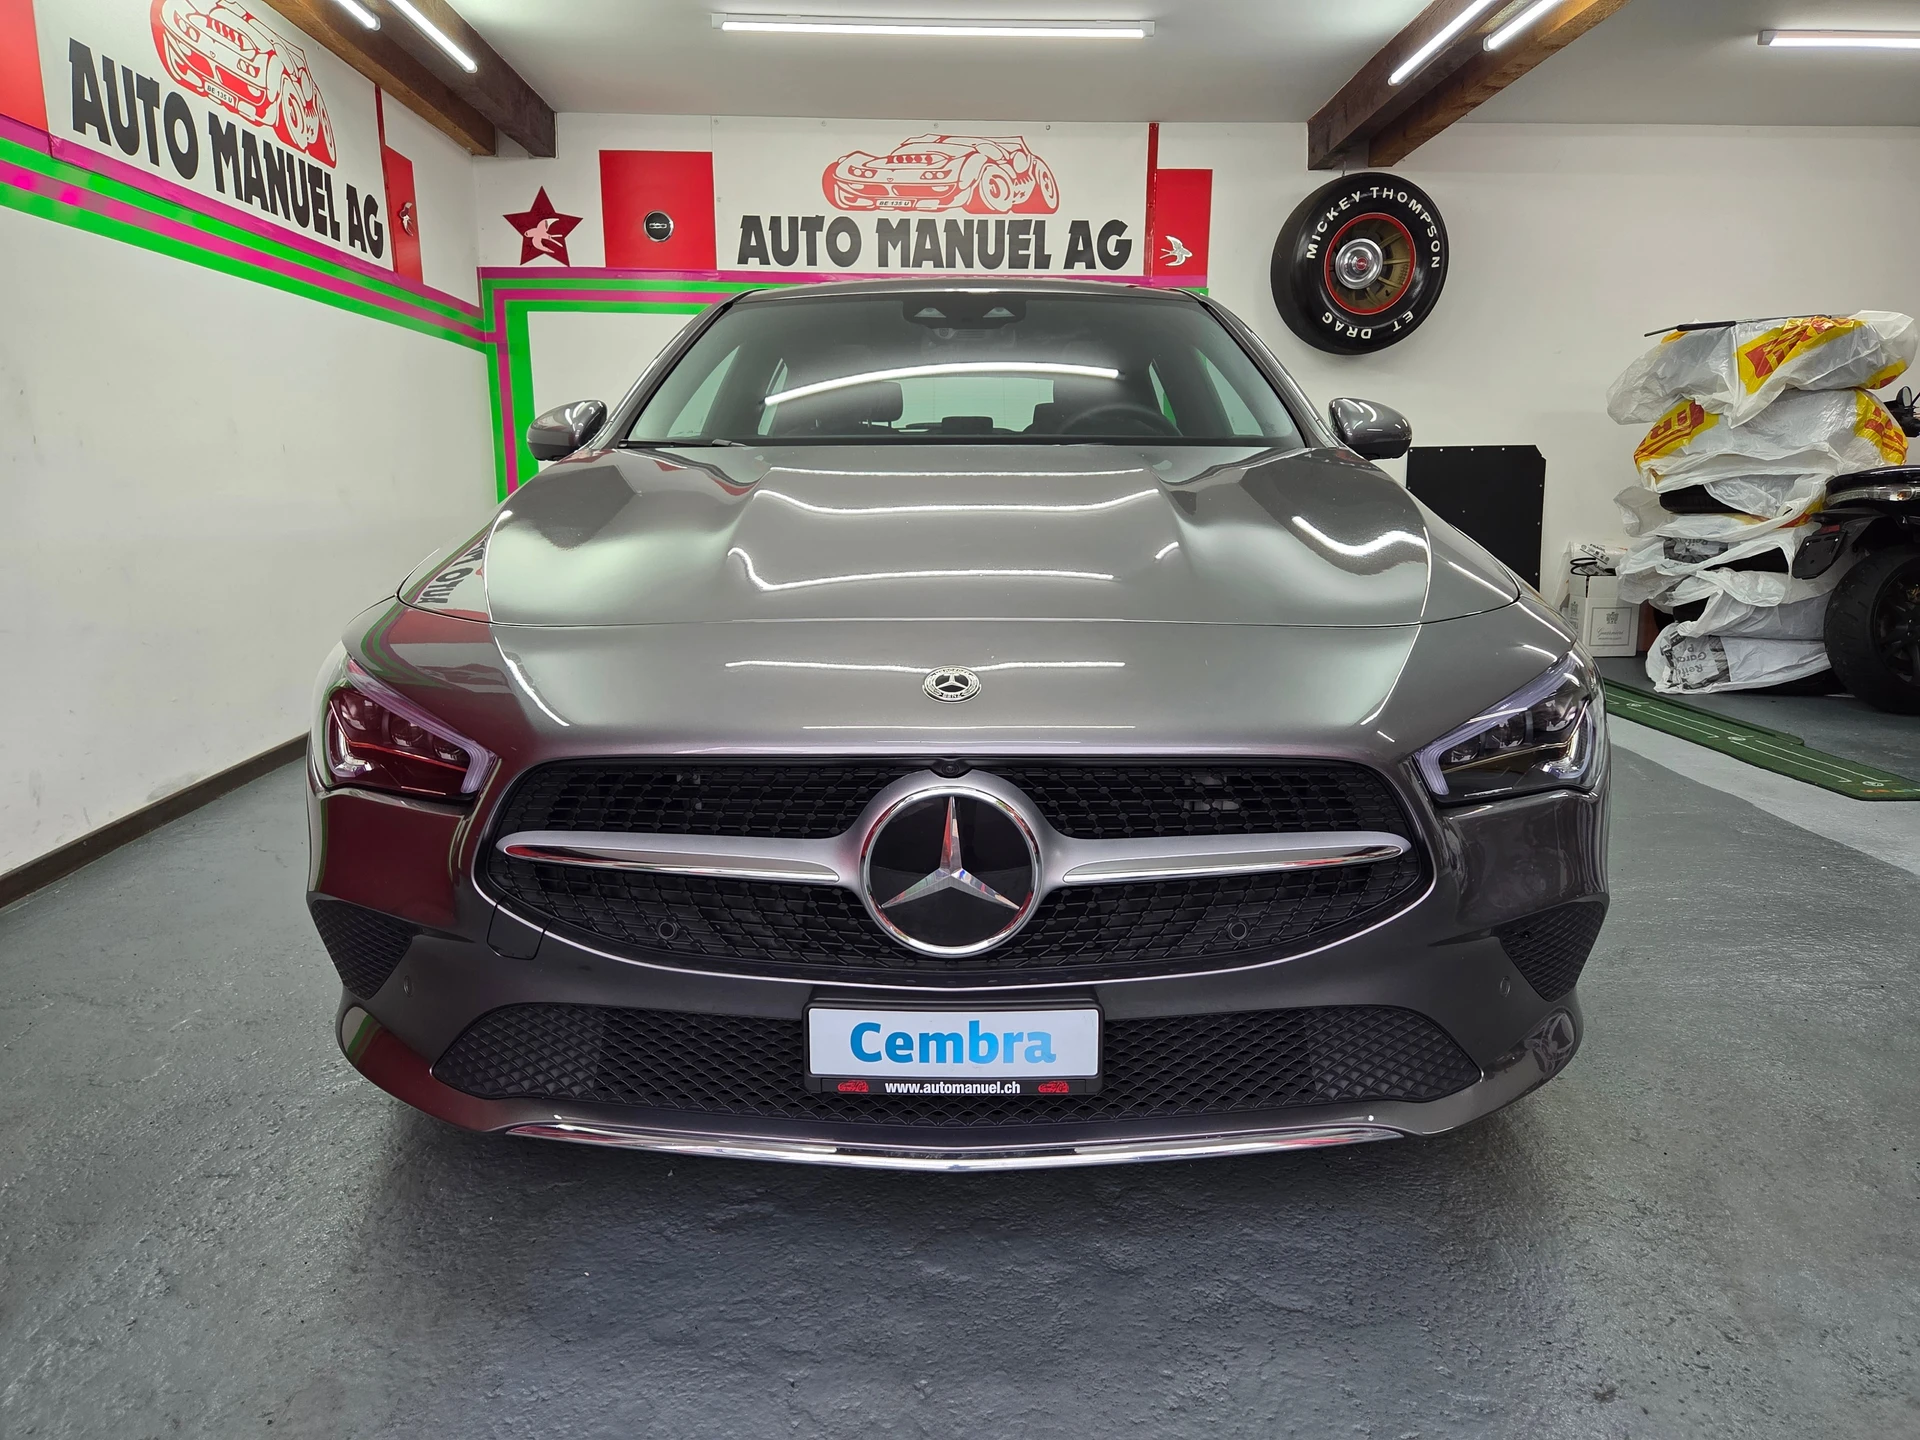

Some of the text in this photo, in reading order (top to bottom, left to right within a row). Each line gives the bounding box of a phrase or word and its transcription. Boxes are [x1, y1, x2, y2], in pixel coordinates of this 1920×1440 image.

[68, 37, 384, 259] AUTO MANUEL AG
[737, 214, 1133, 270] AUTO MANUEL AG
[1306, 186, 1441, 268] MICKEY THOMPSON
[1322, 310, 1414, 339] ET DRAG
[849, 1019, 1057, 1065] Cembra
[884, 1080, 1021, 1095] www.automanuel.ch
